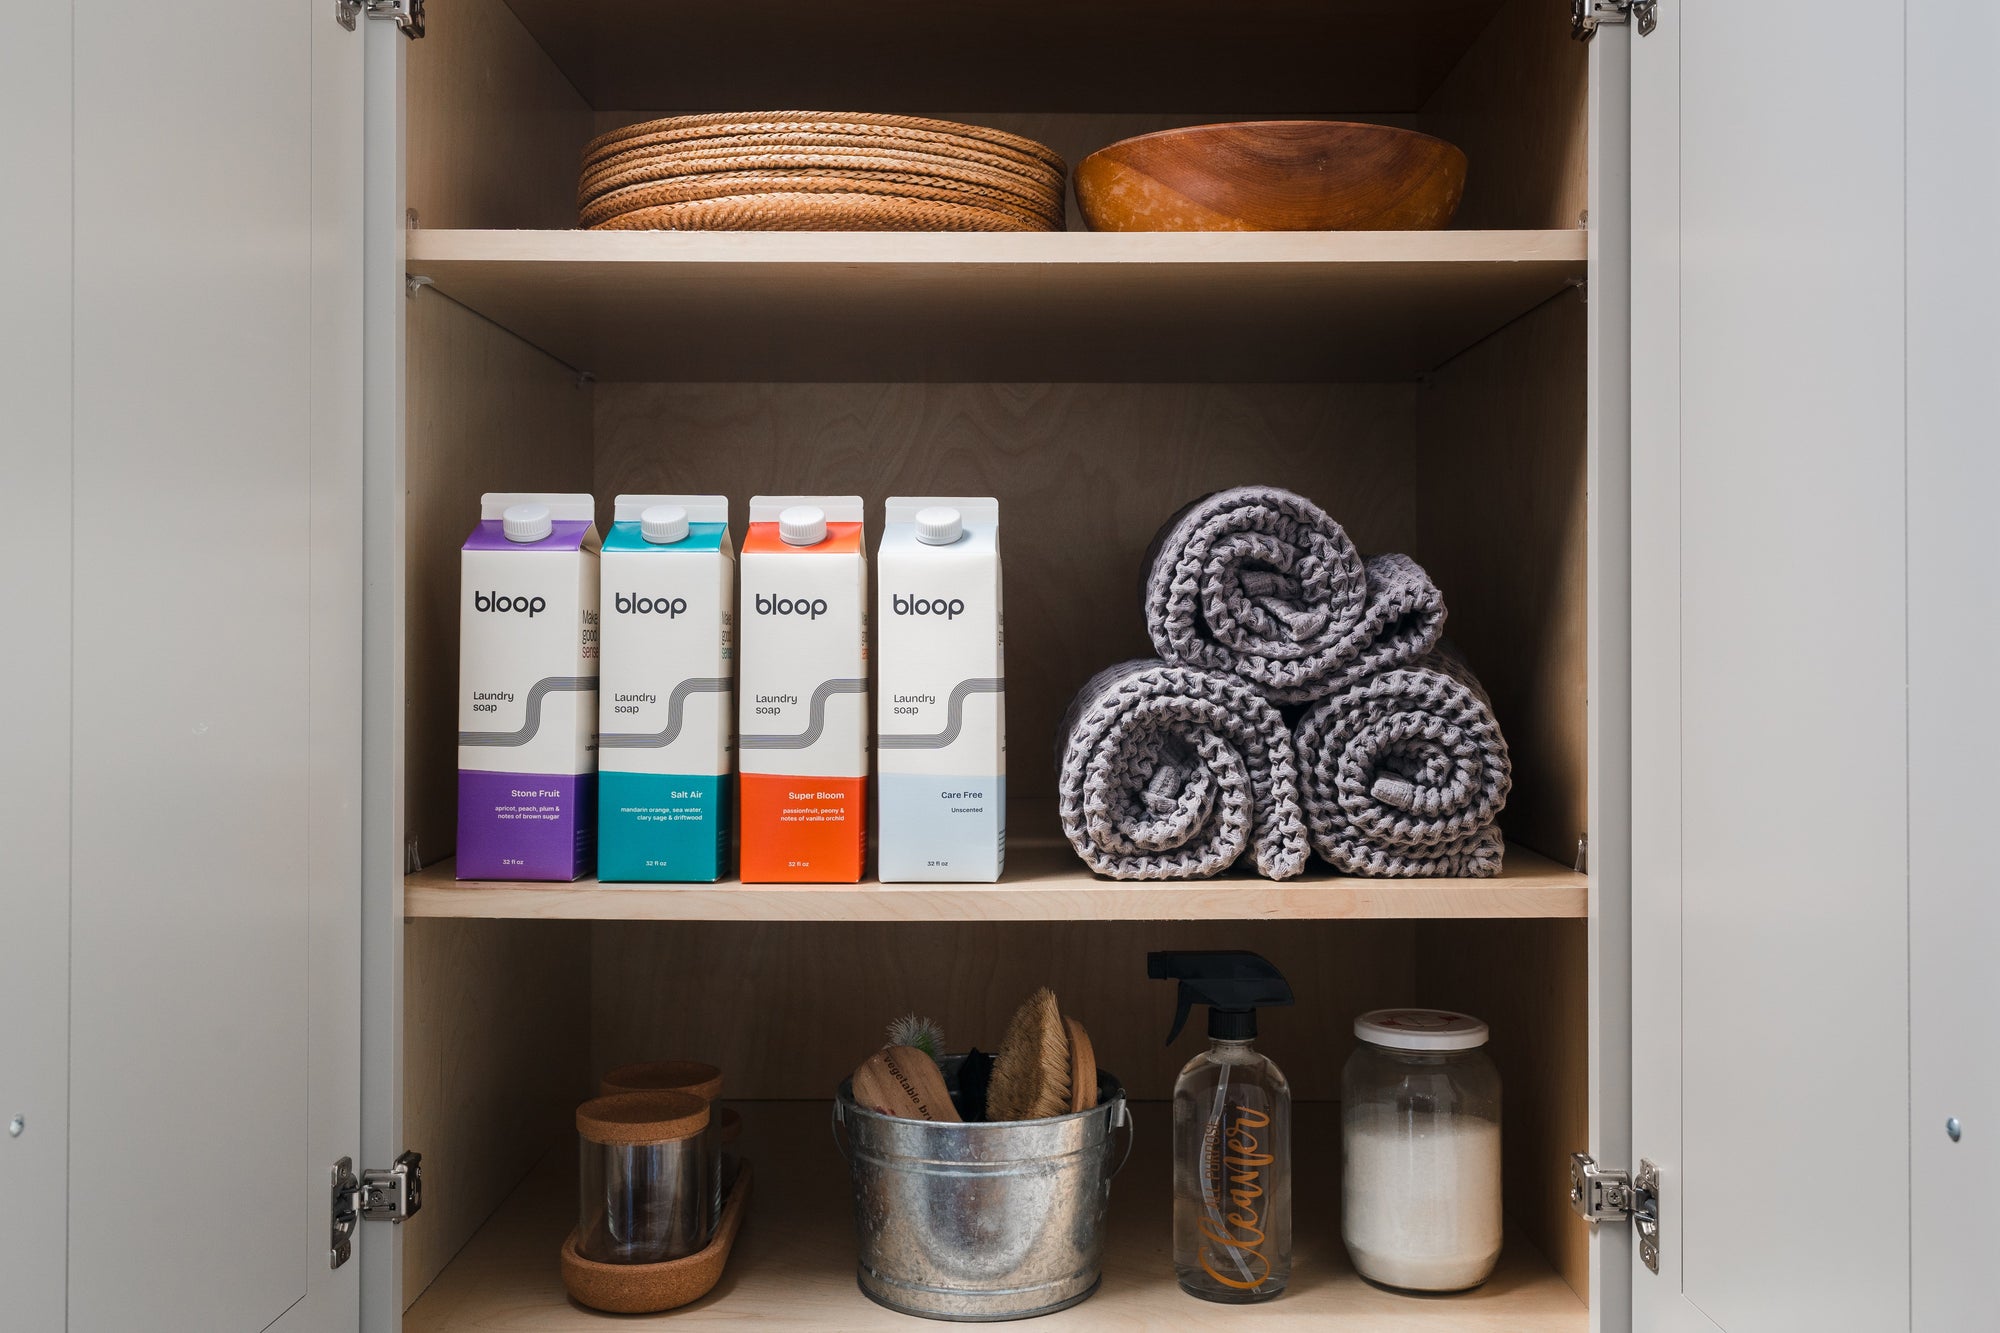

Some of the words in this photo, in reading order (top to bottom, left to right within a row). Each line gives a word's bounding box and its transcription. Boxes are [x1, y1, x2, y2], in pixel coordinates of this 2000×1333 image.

[474, 590, 546, 618] bloop
[615, 592, 687, 619] bloop
[755, 593, 828, 620] bloop
[892, 593, 965, 620] bloop
[473, 691, 514, 702] Laundry
[614, 693, 656, 704] Laundry
[755, 694, 798, 705] Laundry
[893, 694, 936, 705] Laundry
[473, 703, 498, 713] soap
[614, 704, 640, 715] soap
[755, 705, 781, 716] soap
[893, 705, 919, 716] soap
[511, 789, 537, 798] Stone
[539, 789, 560, 798] Fruit
[671, 790, 688, 799] Salt
[690, 790, 703, 799] Air
[788, 792, 815, 801] Super
[816, 791, 845, 800] Bloom
[941, 791, 961, 799] Care
[963, 791, 983, 799] Free
[783, 807, 820, 815] passionfruit,
[637, 814, 652, 822] clary
[883, 1056, 920, 1105] vegetable
[1197, 1105, 1275, 1289] Cleaner
[1204, 1186, 1220, 1209] ALL
